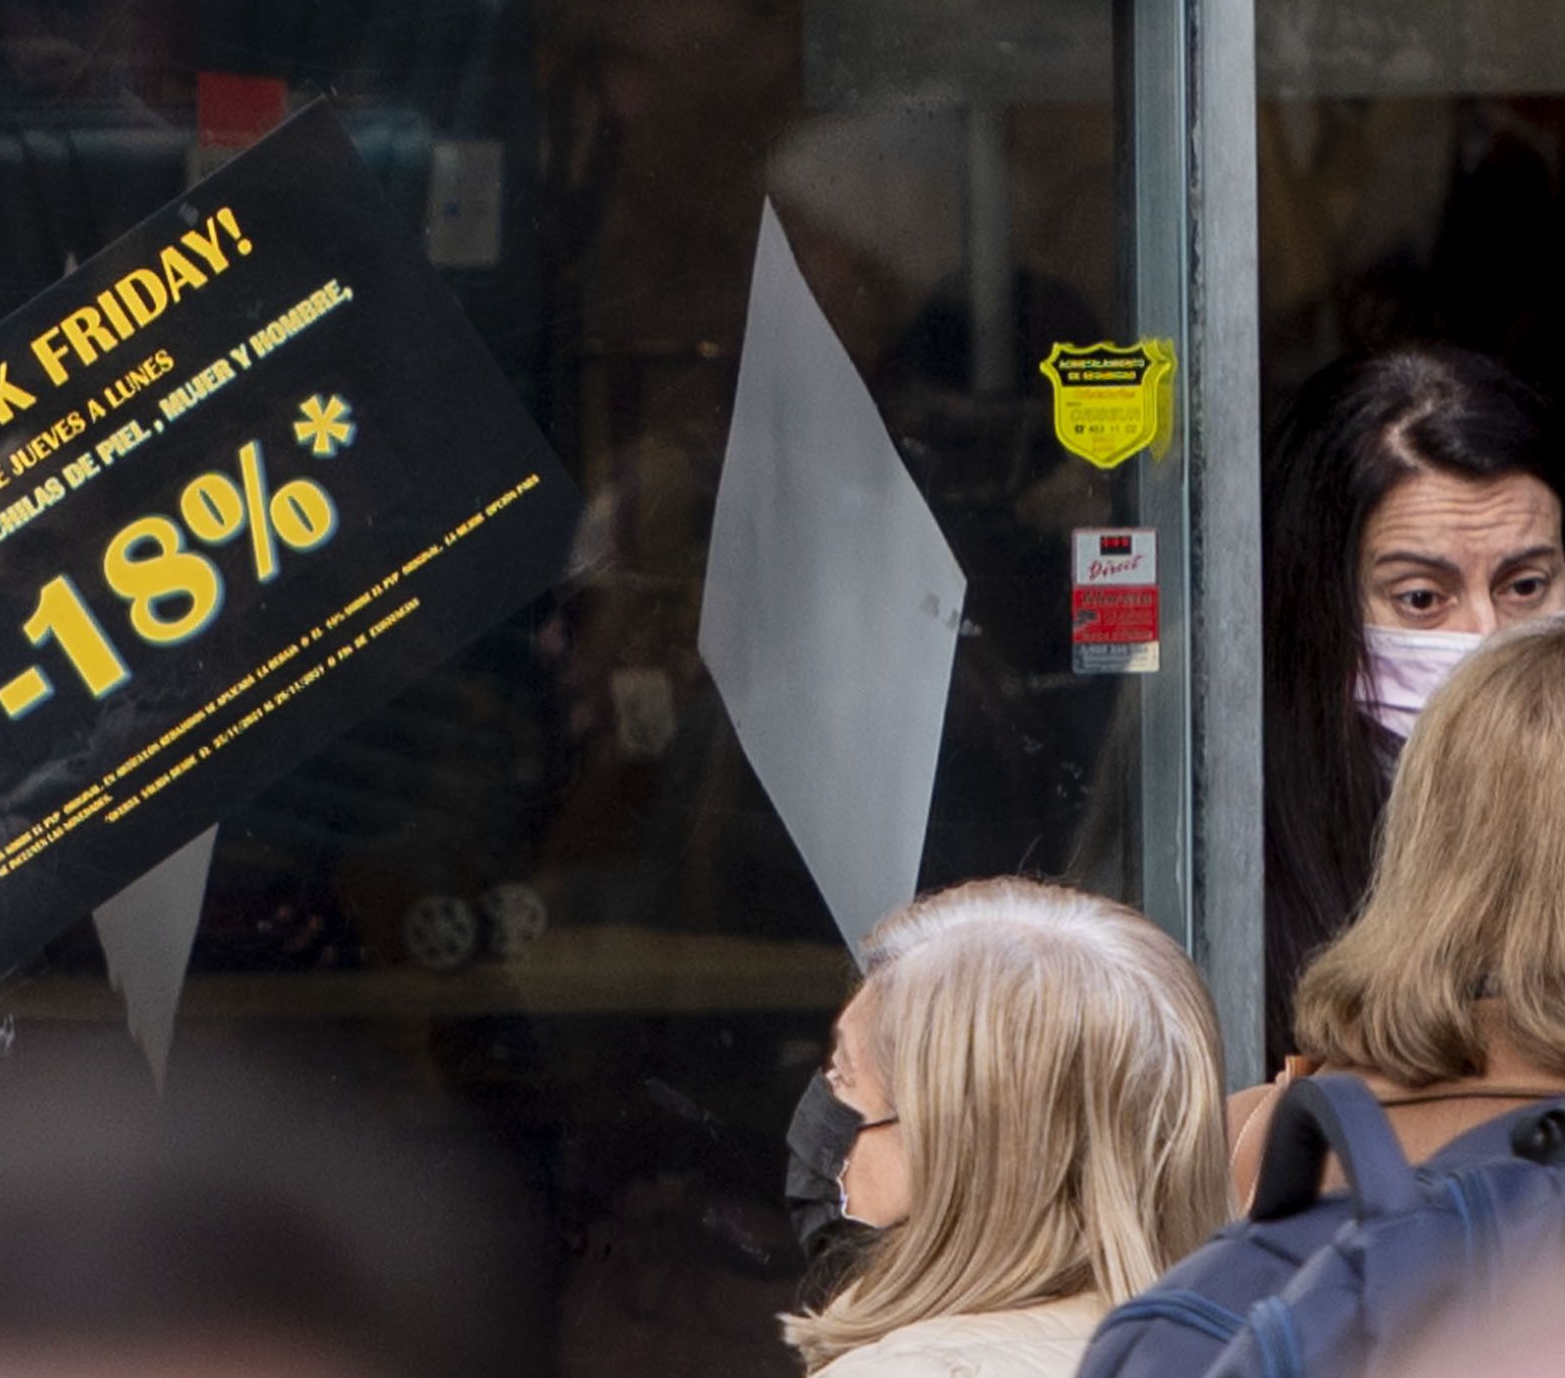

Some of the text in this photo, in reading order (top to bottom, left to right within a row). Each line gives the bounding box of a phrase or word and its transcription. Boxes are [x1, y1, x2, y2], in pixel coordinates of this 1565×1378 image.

[31, 208, 252, 386] FRIDAY!
[62, 452, 101, 489] DE
[95, 420, 152, 465] PIEL
[159, 359, 236, 421] MUJER
[229, 343, 251, 369] Y
[249, 279, 353, 358] HOMBRE,
[9, 412, 86, 476] JUEVES
[88, 399, 106, 423] A
[104, 350, 174, 408] LUNES
